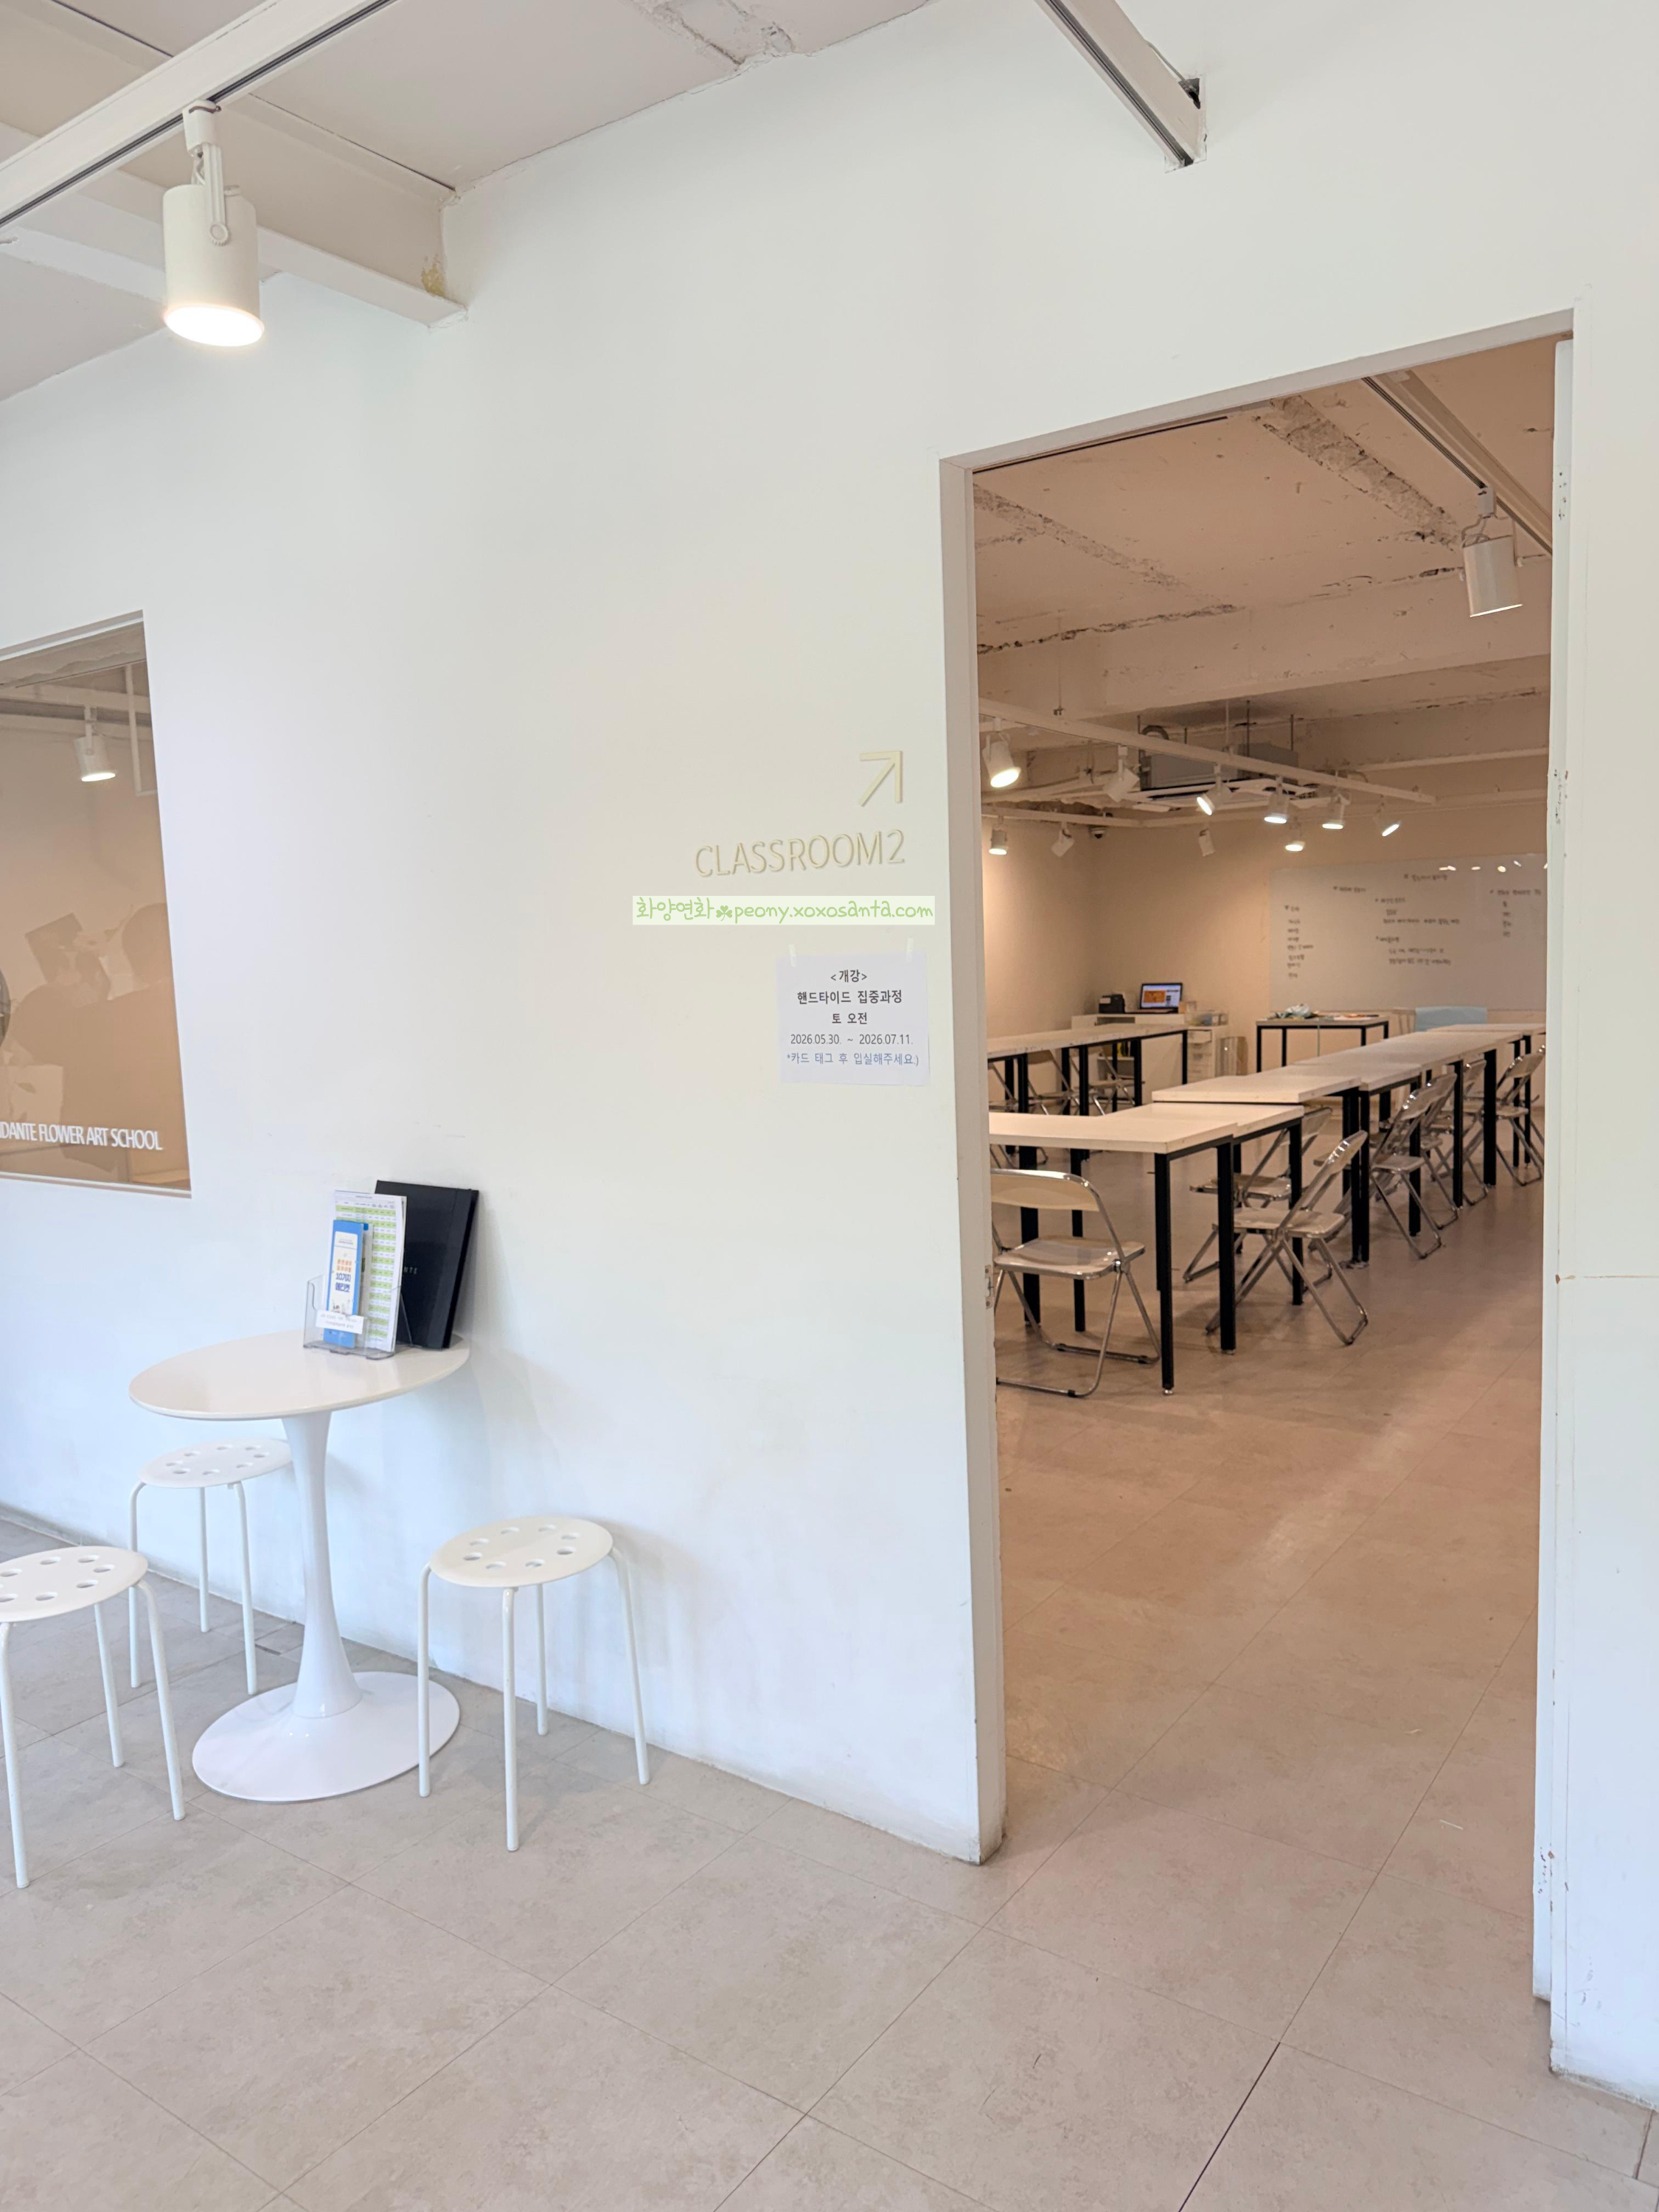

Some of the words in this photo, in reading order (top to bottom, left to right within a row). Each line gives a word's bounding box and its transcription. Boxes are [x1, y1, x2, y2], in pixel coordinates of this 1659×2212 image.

[695, 829, 905, 877] CLASSROOM2
[797, 991, 851, 1004] 핸드타이드
[858, 990, 902, 1004] 집중과정
[832, 1014, 841, 1023] 토
[847, 1012, 868, 1024] 오전
[790, 1034, 841, 1045] 2026.05.30.
[859, 1034, 914, 1045] 2026.07.11.
[815, 1053, 833, 1064] 태그
[839, 1053, 848, 1064] 후
[38, 1123, 86, 1144] FLOWER
[86, 1127, 109, 1146] ART
[110, 1128, 163, 1150] SCHOOL
